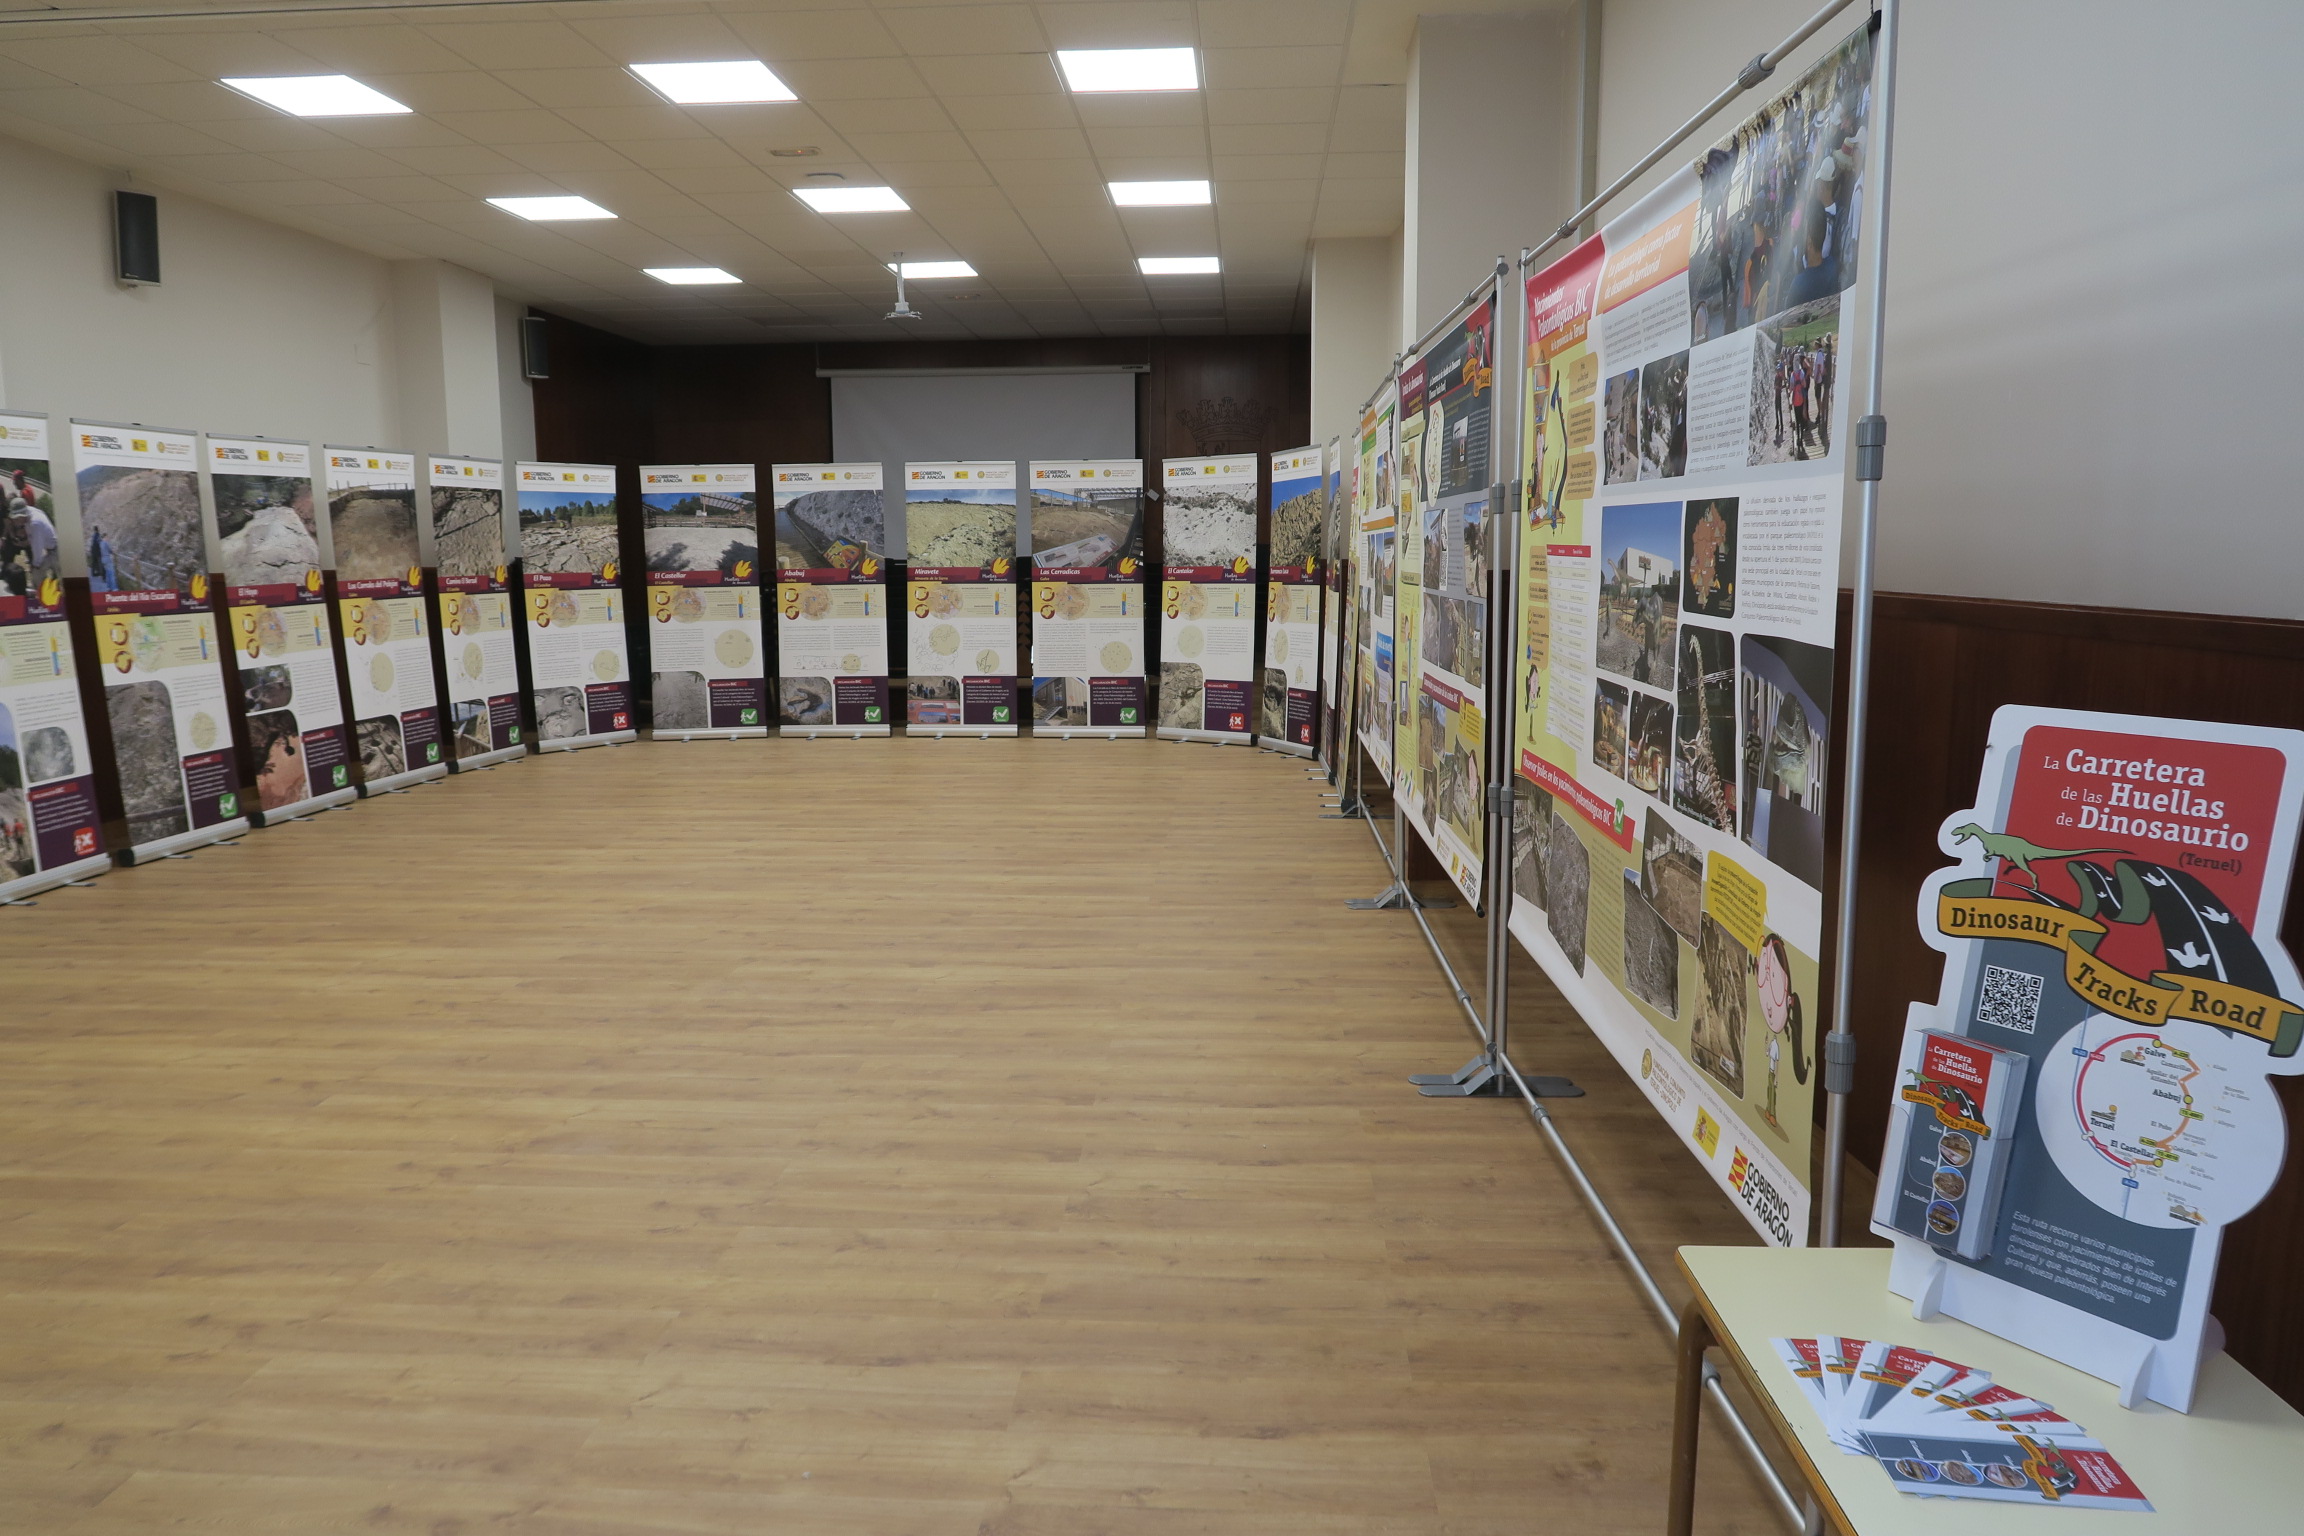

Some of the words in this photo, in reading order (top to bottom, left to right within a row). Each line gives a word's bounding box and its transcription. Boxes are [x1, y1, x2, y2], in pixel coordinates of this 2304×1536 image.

[1575, 282, 1591, 317] BIC
[2044, 756, 2060, 770] La
[2066, 748, 2205, 787] Carretera
[1523, 755, 1537, 773] Observar
[1548, 771, 1553, 780] en
[1603, 809, 1611, 826] BIC
[2061, 787, 2077, 801] de
[2083, 789, 2103, 803] las
[2108, 782, 2225, 820] Huellas
[2056, 812, 2073, 826] de
[2078, 805, 2249, 851] Dinosaurio
[2179, 851, 2242, 876] (Teruel)
[1950, 907, 2065, 939] Dinosaur
[2073, 962, 2158, 1017] Tracks
[2189, 989, 2267, 1031] Road
[1934, 1046, 1972, 1063] Carretera
[1946, 1058, 1977, 1074] Huellas
[2145, 1047, 2166, 1058] Galve
[1938, 1064, 1983, 1084] Dinosaurio
[2152, 1089, 2181, 1103] Ababuj
[2090, 1118, 2115, 1131] Teruel
[2120, 1142, 2155, 1159] Castellar
[1747, 1162, 1790, 1222] GOBIERNO
[1741, 1180, 1754, 1206] DE
[1753, 1199, 1793, 1247] ARAGON
[2011, 1222, 2052, 1243] turolenses
[2053, 1237, 2069, 1249] con
[2069, 1243, 2121, 1268] yacimientos
[2122, 1259, 2134, 1272] de
[2134, 1265, 2164, 1283] icnitas
[2165, 1275, 2178, 1288] de
[2013, 1210, 2031, 1224] Esta
[2031, 1217, 2049, 1230] ruta
[2049, 1224, 2079, 1241] recorre
[2081, 1235, 2106, 1250] varios
[2107, 1243, 2155, 1267] municipios
[2004, 1257, 2024, 1269] gran
[2024, 1263, 2053, 1280] riqueza
[2053, 1274, 2116, 1304] paleontológica.
[2007, 1244, 2037, 1263] Cultural
[2038, 1255, 2043, 1266] y
[2045, 1259, 2062, 1273] que,
[2064, 1266, 2099, 1286] además,
[2101, 1281, 2133, 1297] poseen
[2134, 1290, 2151, 1304] una
[2008, 1234, 2056, 1257] dinosaurios
[2056, 1249, 2101, 1273] declarados
[2102, 1266, 2122, 1281] Bien
[2123, 1273, 2135, 1285] de
[2136, 1277, 2167, 1297] Interés
